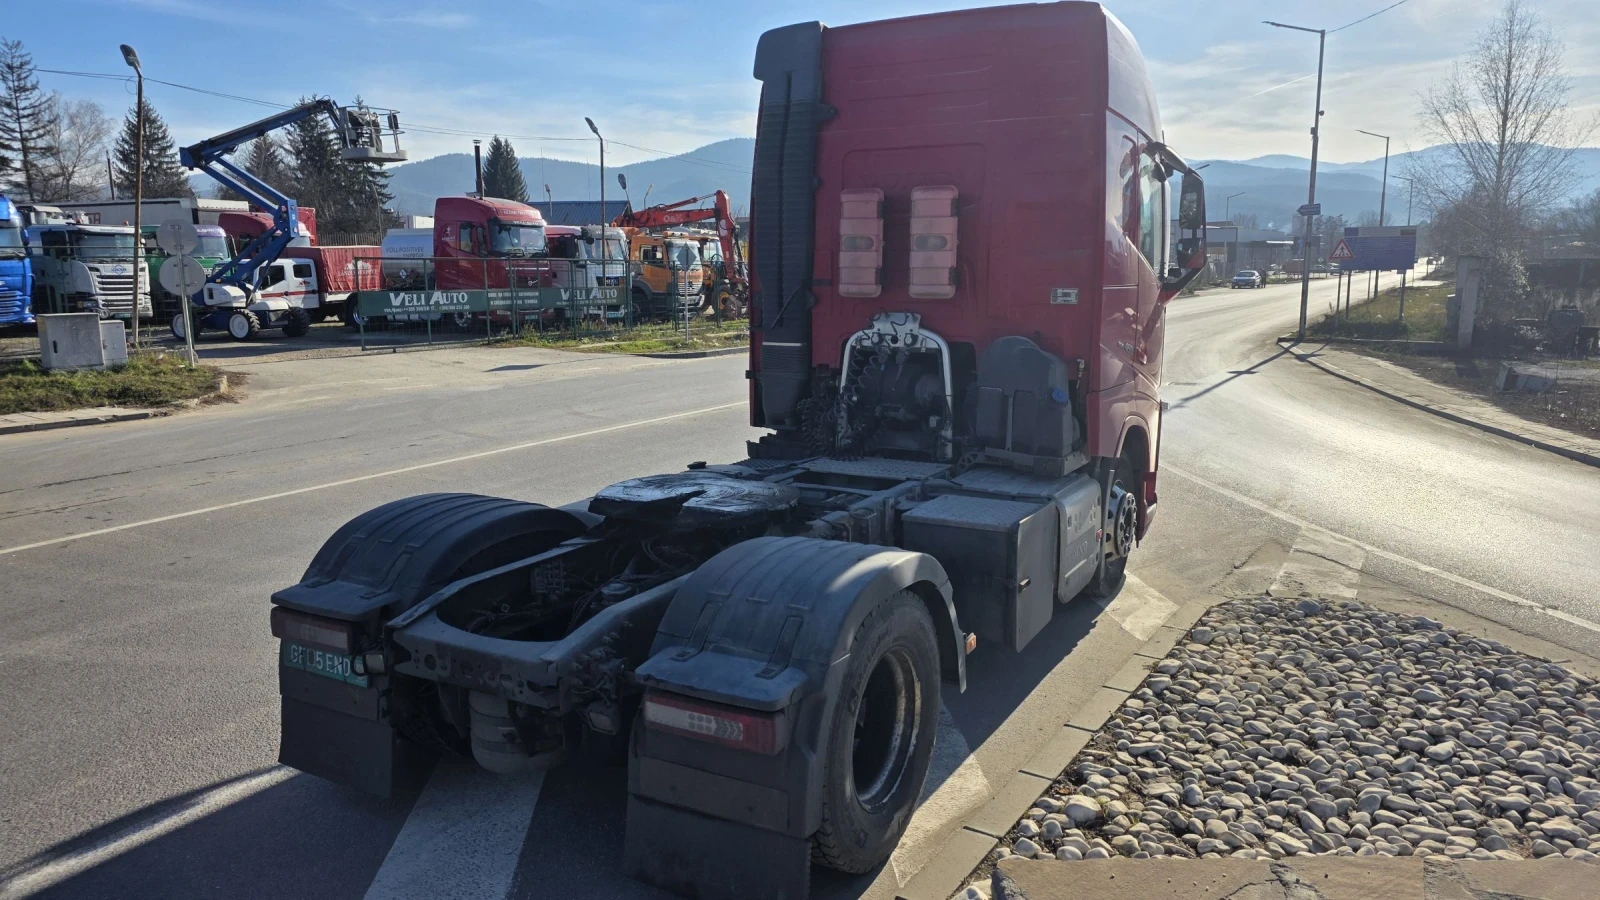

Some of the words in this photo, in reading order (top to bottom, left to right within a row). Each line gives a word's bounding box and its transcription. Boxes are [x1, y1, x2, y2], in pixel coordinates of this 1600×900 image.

[389, 292, 426, 306] VELI
[429, 291, 468, 305] AUTO
[589, 287, 618, 300] AUTO
